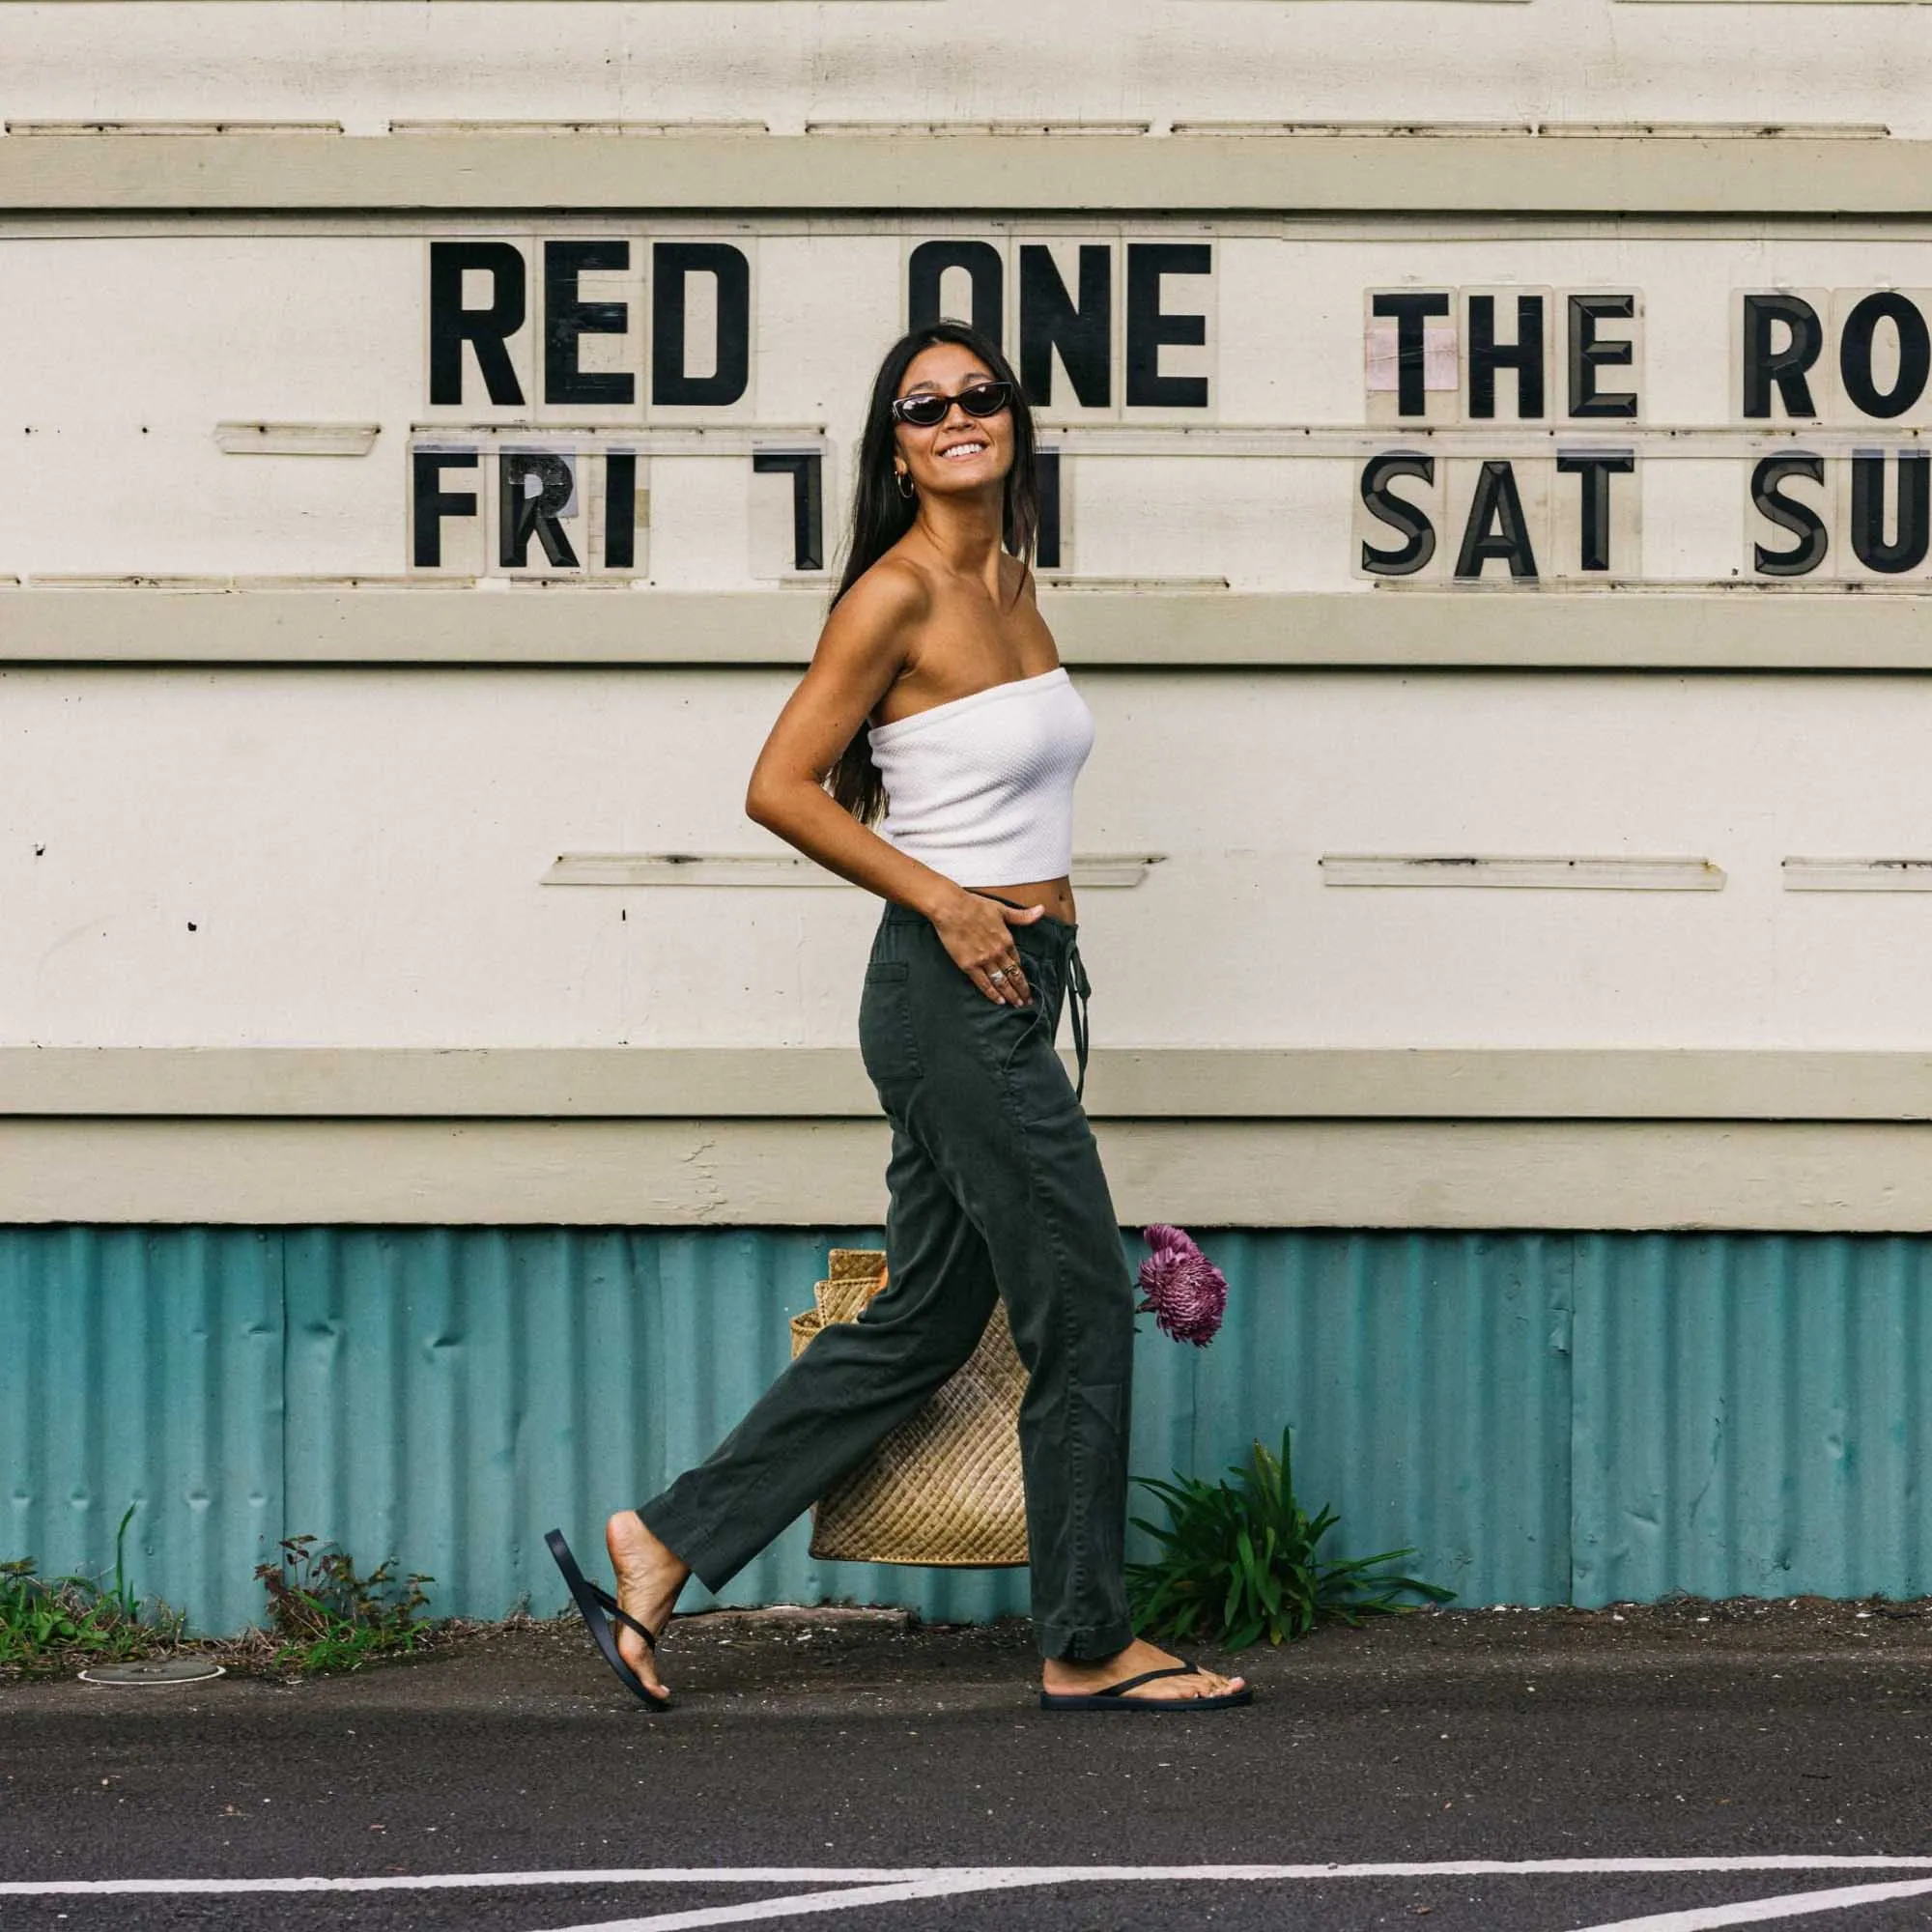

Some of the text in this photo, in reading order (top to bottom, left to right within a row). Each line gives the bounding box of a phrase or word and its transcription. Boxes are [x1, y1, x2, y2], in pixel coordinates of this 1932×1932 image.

[431, 241, 1211, 407] RED ONE
[1374, 292, 1931, 418] THE RO
[413, 447, 635, 568] FRI
[1361, 449, 1930, 583] SAT SU
